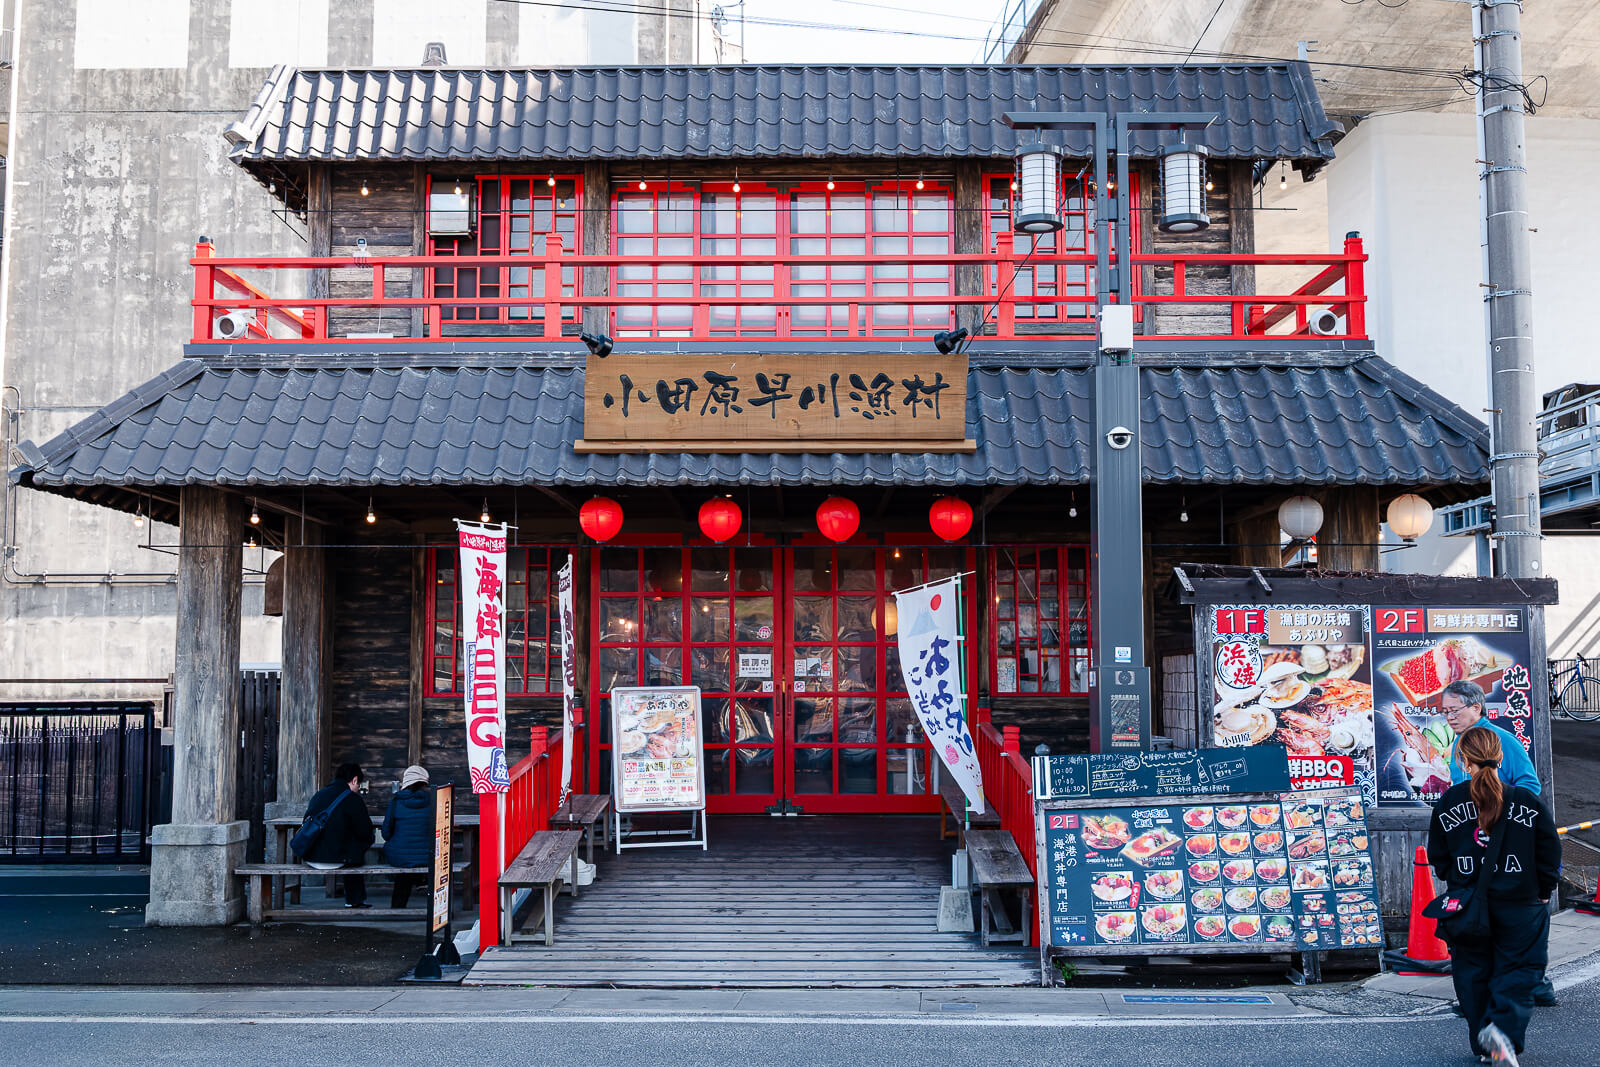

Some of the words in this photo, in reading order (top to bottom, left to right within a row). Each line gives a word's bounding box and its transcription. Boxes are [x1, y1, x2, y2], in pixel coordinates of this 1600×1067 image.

[603, 370, 951, 420] 小田原早川漁村
[1225, 611, 1259, 634] 1F
[1280, 612, 1351, 627] 漁師の浜焼
[1383, 610, 1418, 633] 2F
[1433, 613, 1519, 629] 海鮮丼専門店
[1289, 629, 1344, 642] あぶりや
[1223, 642, 1257, 686] 浜焼
[1222, 732, 1251, 746] 小田原
[1052, 815, 1075, 829] 2F
[1439, 801, 1538, 832] AVIX
[1065, 833, 1077, 867] 漁港の
[1053, 838, 1068, 913] 海鮮丼専門店
[1457, 854, 1522, 875] UA
